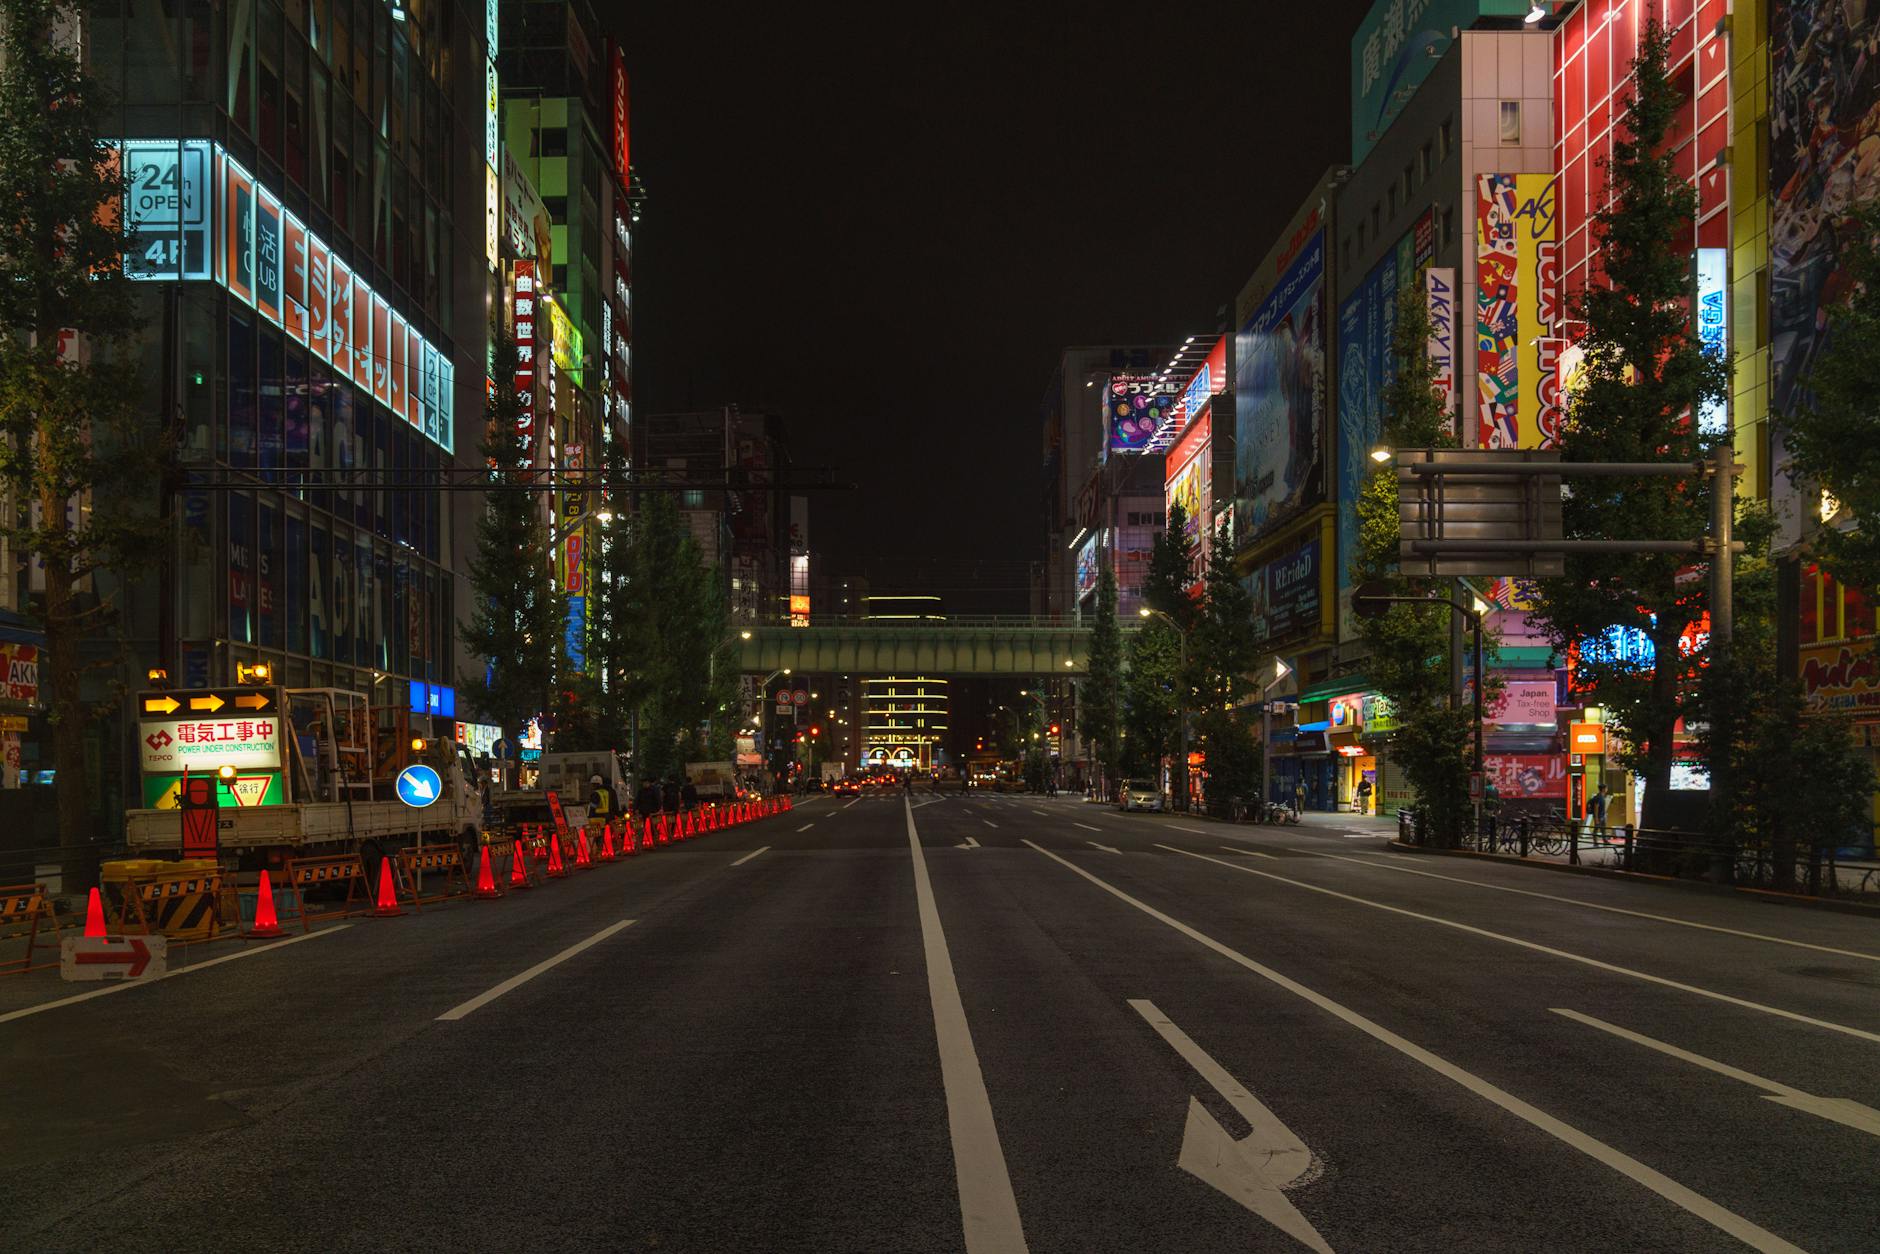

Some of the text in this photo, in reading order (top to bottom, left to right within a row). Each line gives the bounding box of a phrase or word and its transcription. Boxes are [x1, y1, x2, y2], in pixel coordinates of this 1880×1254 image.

[140, 195, 191, 210] OPEN
[144, 239, 187, 265] 4F
[1703, 291, 1723, 357] SEGA
[567, 535, 582, 592] DVD
[1517, 700, 1550, 708] Tax-free
[1529, 709, 1550, 717] Shop
[178, 720, 273, 743] 電気工事中
[178, 742, 275, 753] POWER UNDER CONSTRUCTION
[239, 783, 259, 794] 徐行
